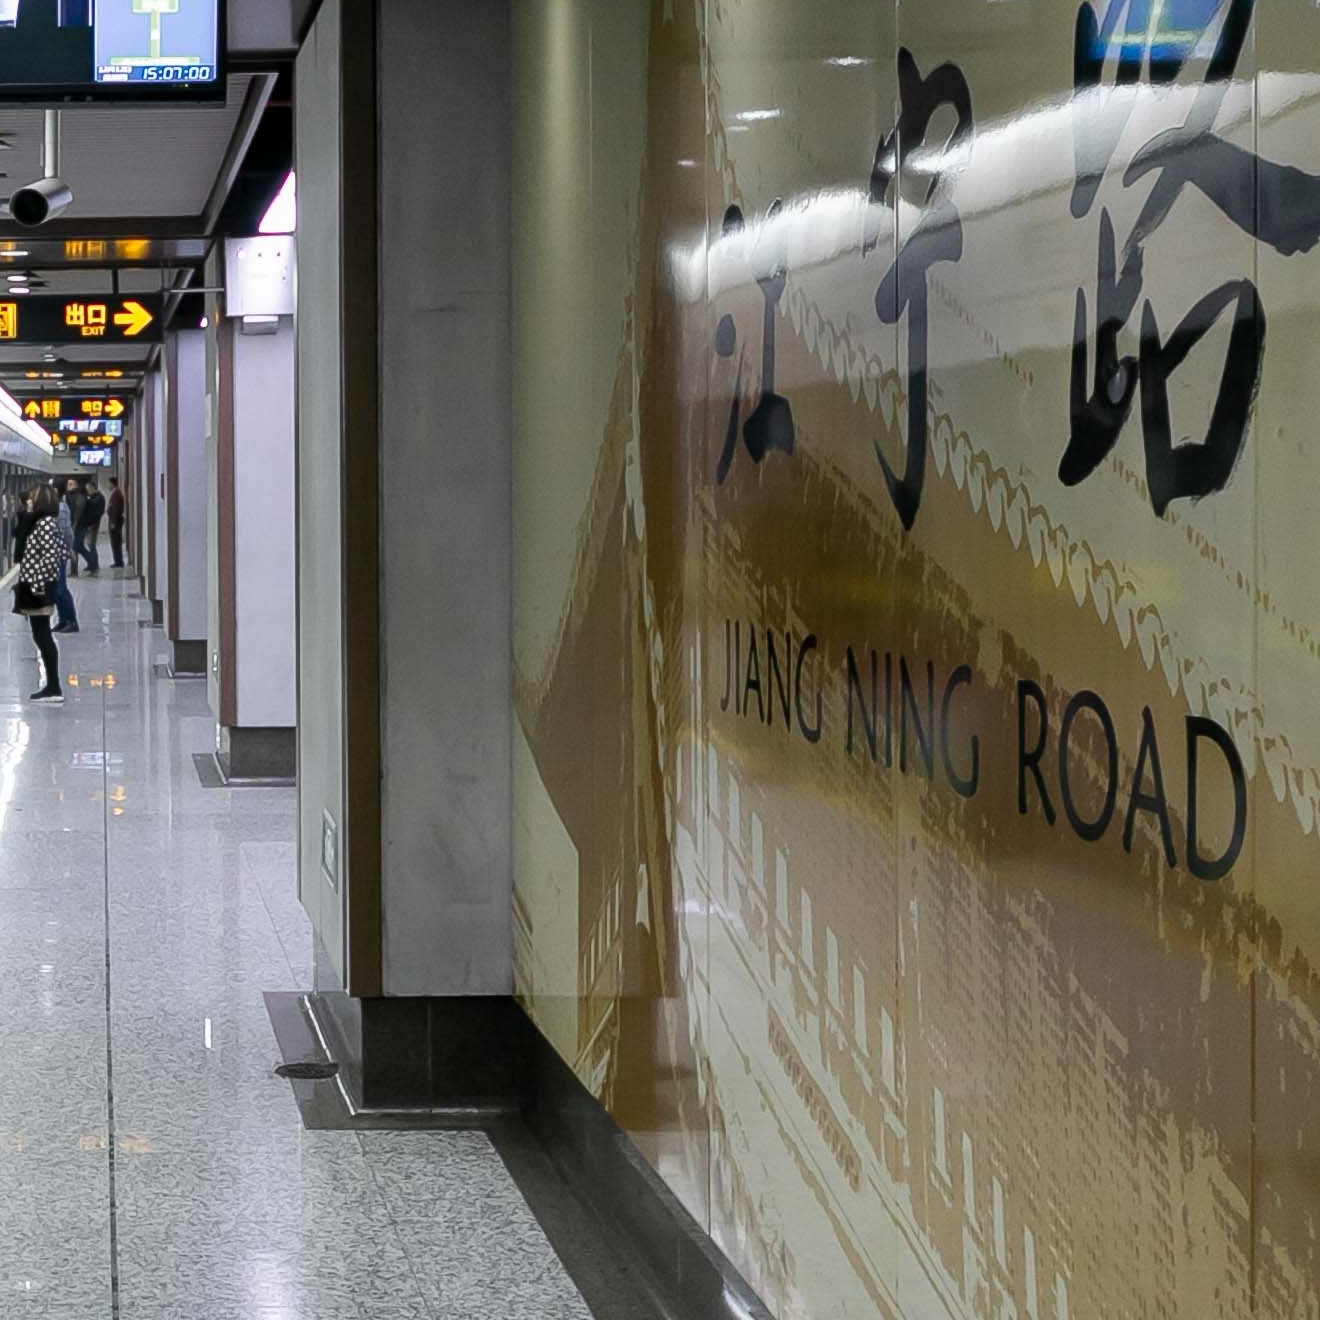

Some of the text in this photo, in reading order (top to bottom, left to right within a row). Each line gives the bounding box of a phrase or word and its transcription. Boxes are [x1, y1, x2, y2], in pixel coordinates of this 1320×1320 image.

[143, 66, 210, 80] 15:07:00
[66, 303, 106, 325] 出口
[81, 326, 106, 336] EXIT
[721, 617, 1249, 881] JIANG NING ROAD
